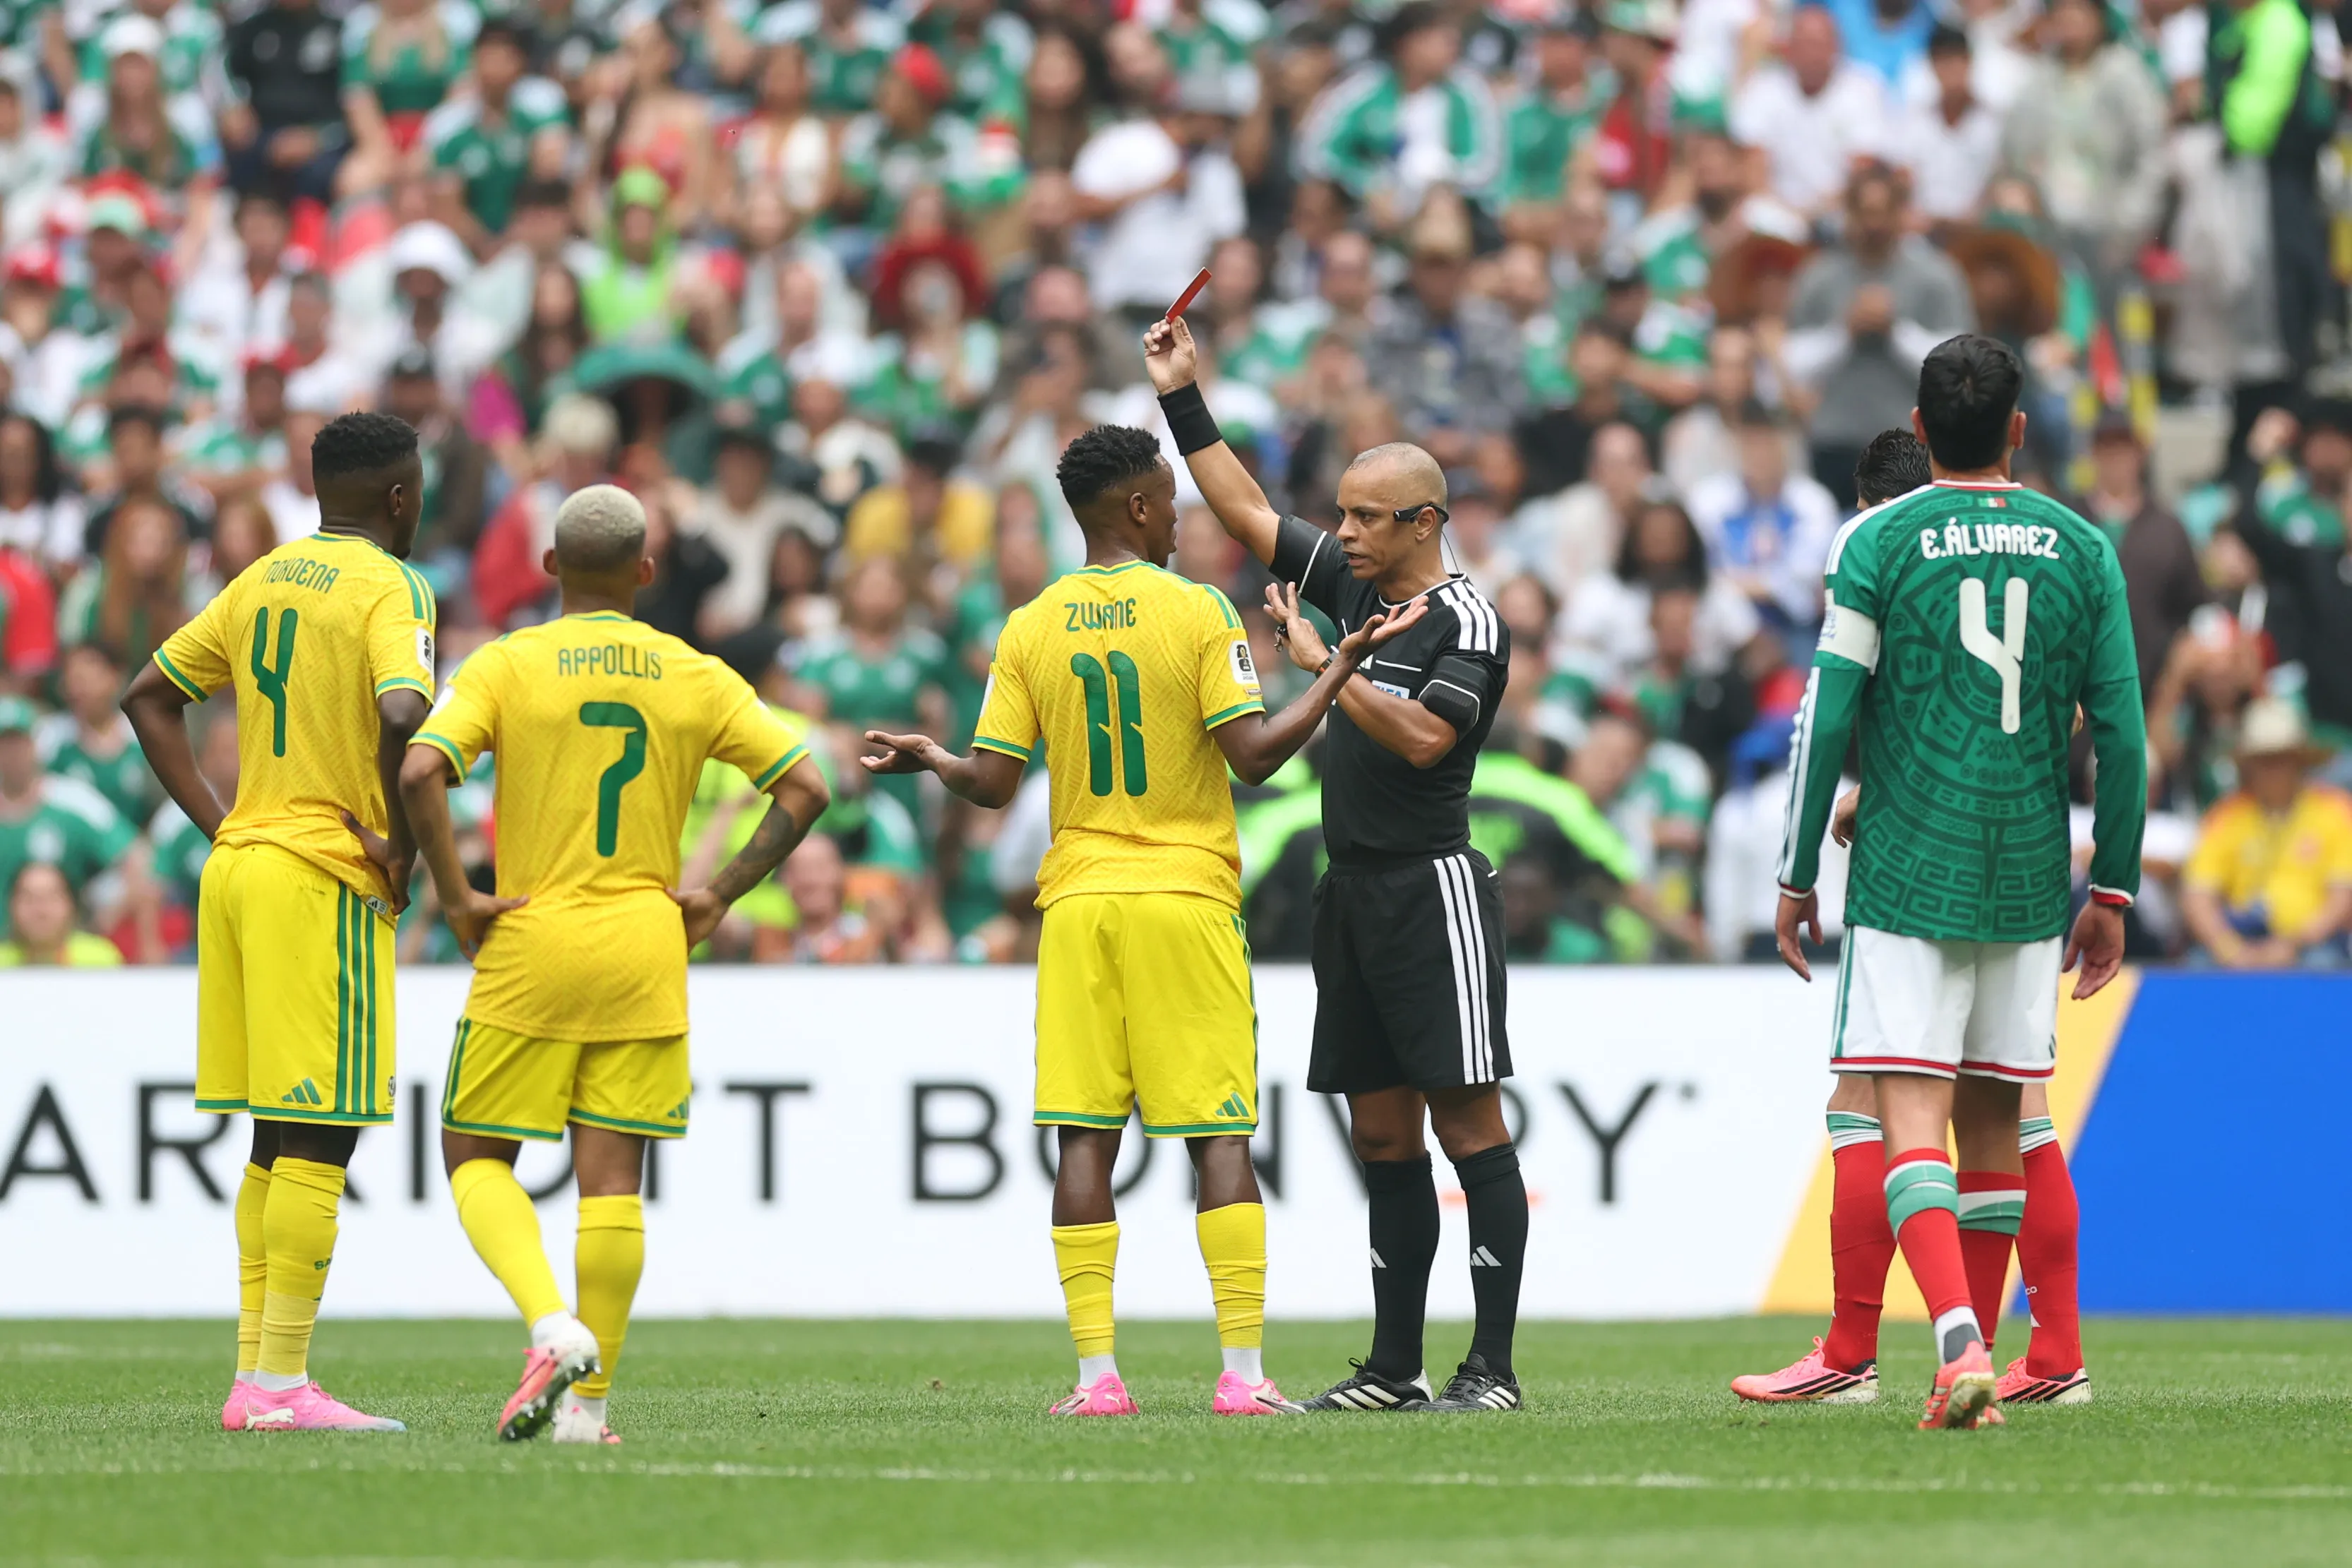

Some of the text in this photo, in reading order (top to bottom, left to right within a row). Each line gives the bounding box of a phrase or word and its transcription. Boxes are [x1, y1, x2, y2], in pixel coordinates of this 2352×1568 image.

[1920, 517, 2060, 560] E.ÁLVAREZ
[559, 643, 662, 680] APPOLLIS
[1064, 597, 1136, 632] ZWANE
[1959, 576, 2029, 734] 4
[251, 606, 298, 758] 4
[1070, 650, 1147, 796] 11
[579, 702, 647, 857] 7
[0, 1082, 811, 1203] ARIT
